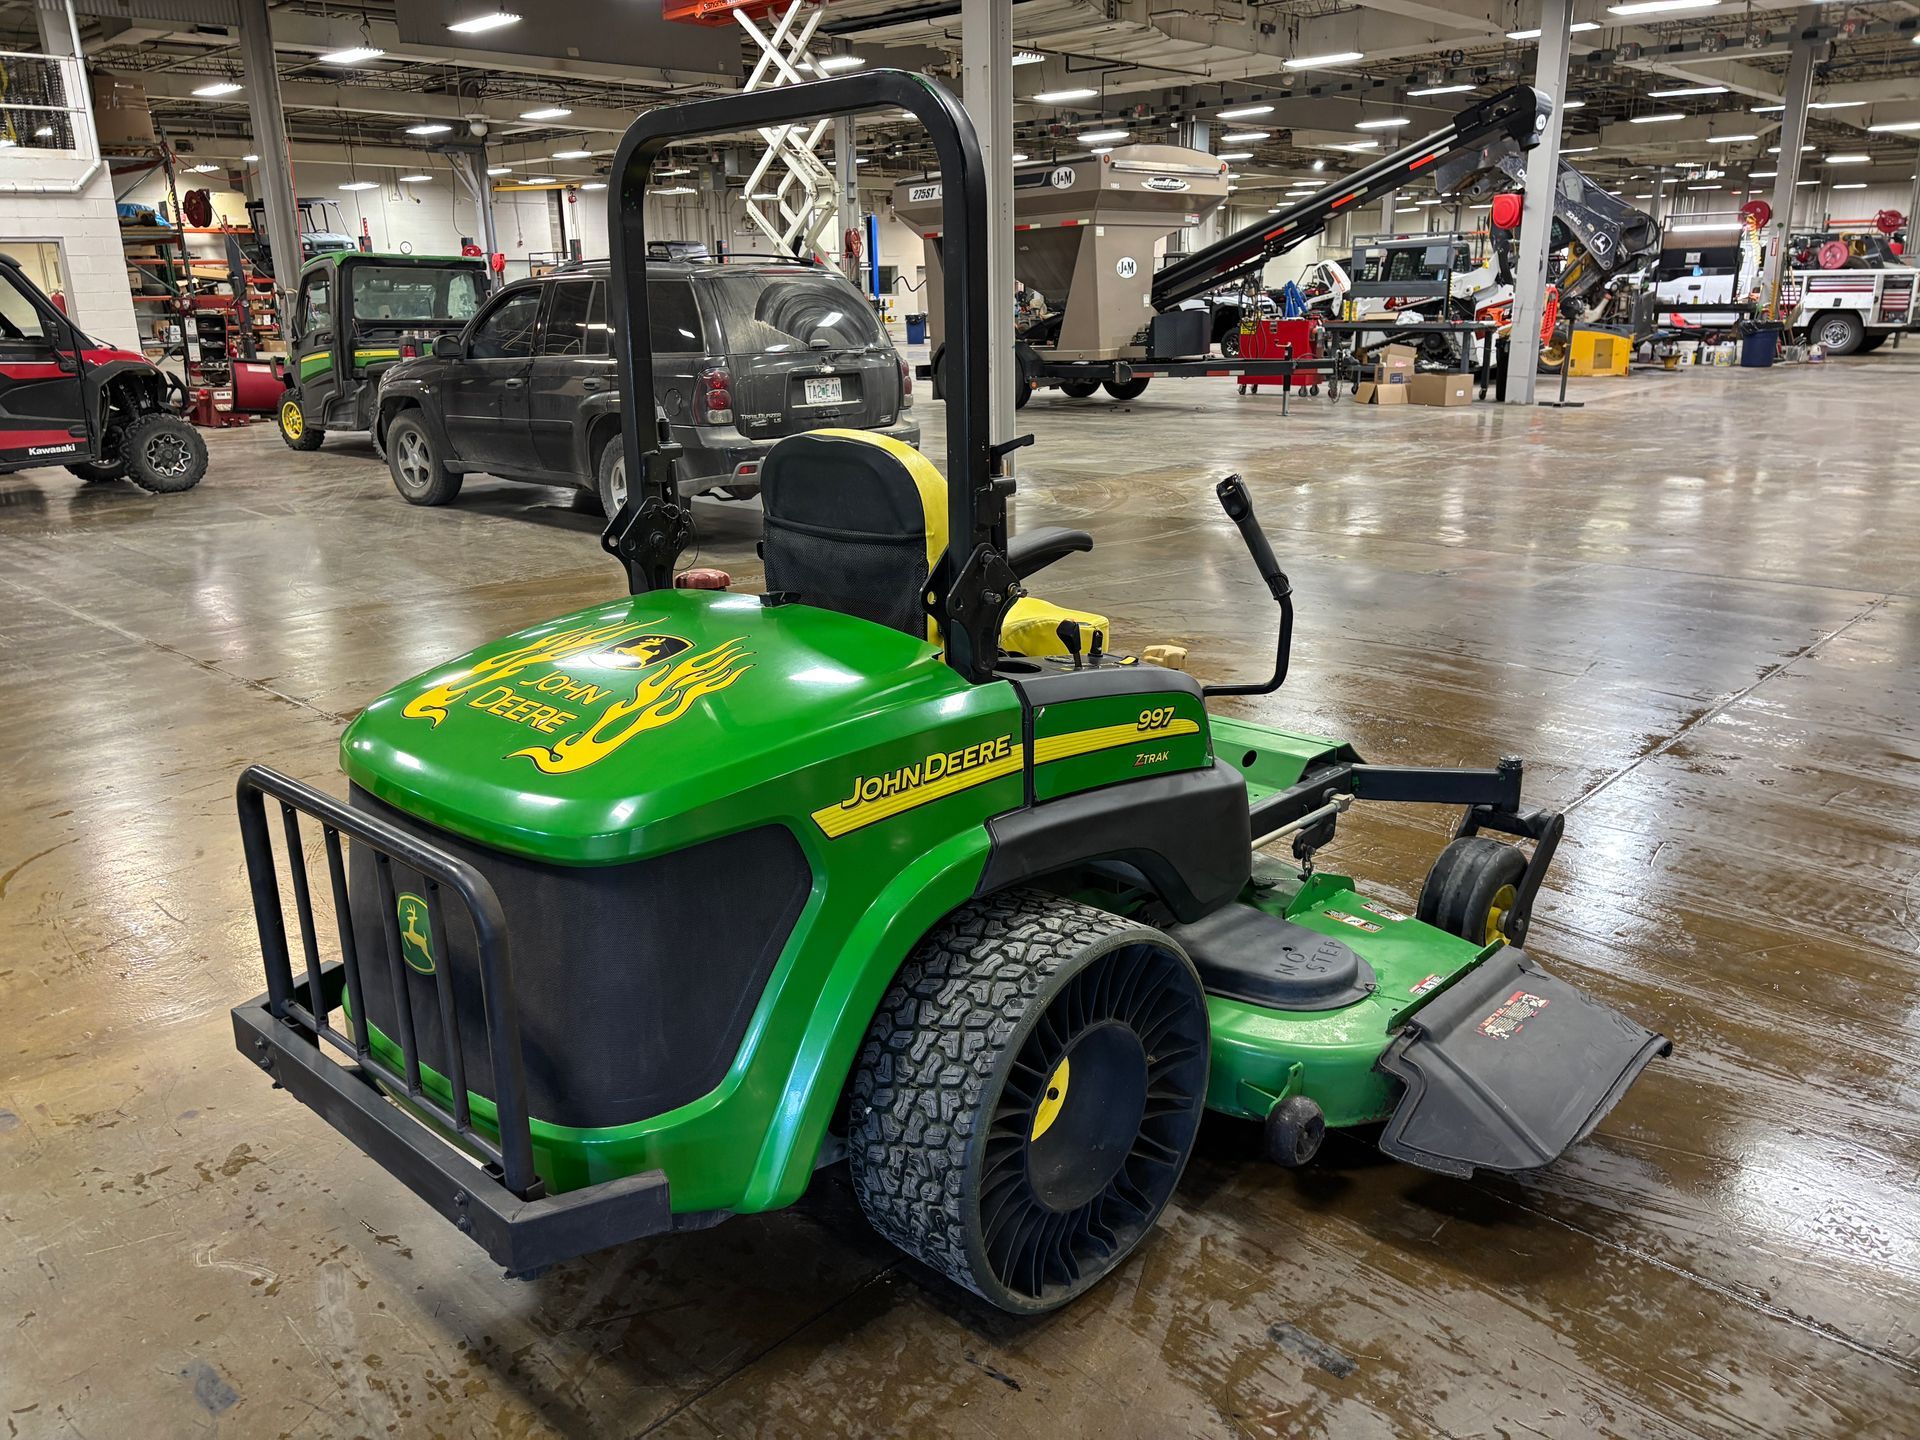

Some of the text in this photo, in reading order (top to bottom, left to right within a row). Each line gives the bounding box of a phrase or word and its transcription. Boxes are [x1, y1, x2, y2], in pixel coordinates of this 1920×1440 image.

[1705, 38, 1716, 48] 93
[1750, 34, 1761, 44] 95
[1053, 170, 1072, 186] J&M
[913, 187, 936, 200] 275ST
[1118, 261, 1134, 275] J&M
[28, 443, 76, 456] Kawasaki
[518, 669, 614, 707] JOHN
[467, 685, 580, 734] DEERE
[1136, 706, 1176, 732] 997
[841, 734, 1012, 809] JOHN DEERE
[1274, 951, 1306, 976] NO
[1305, 940, 1345, 973] STEP
